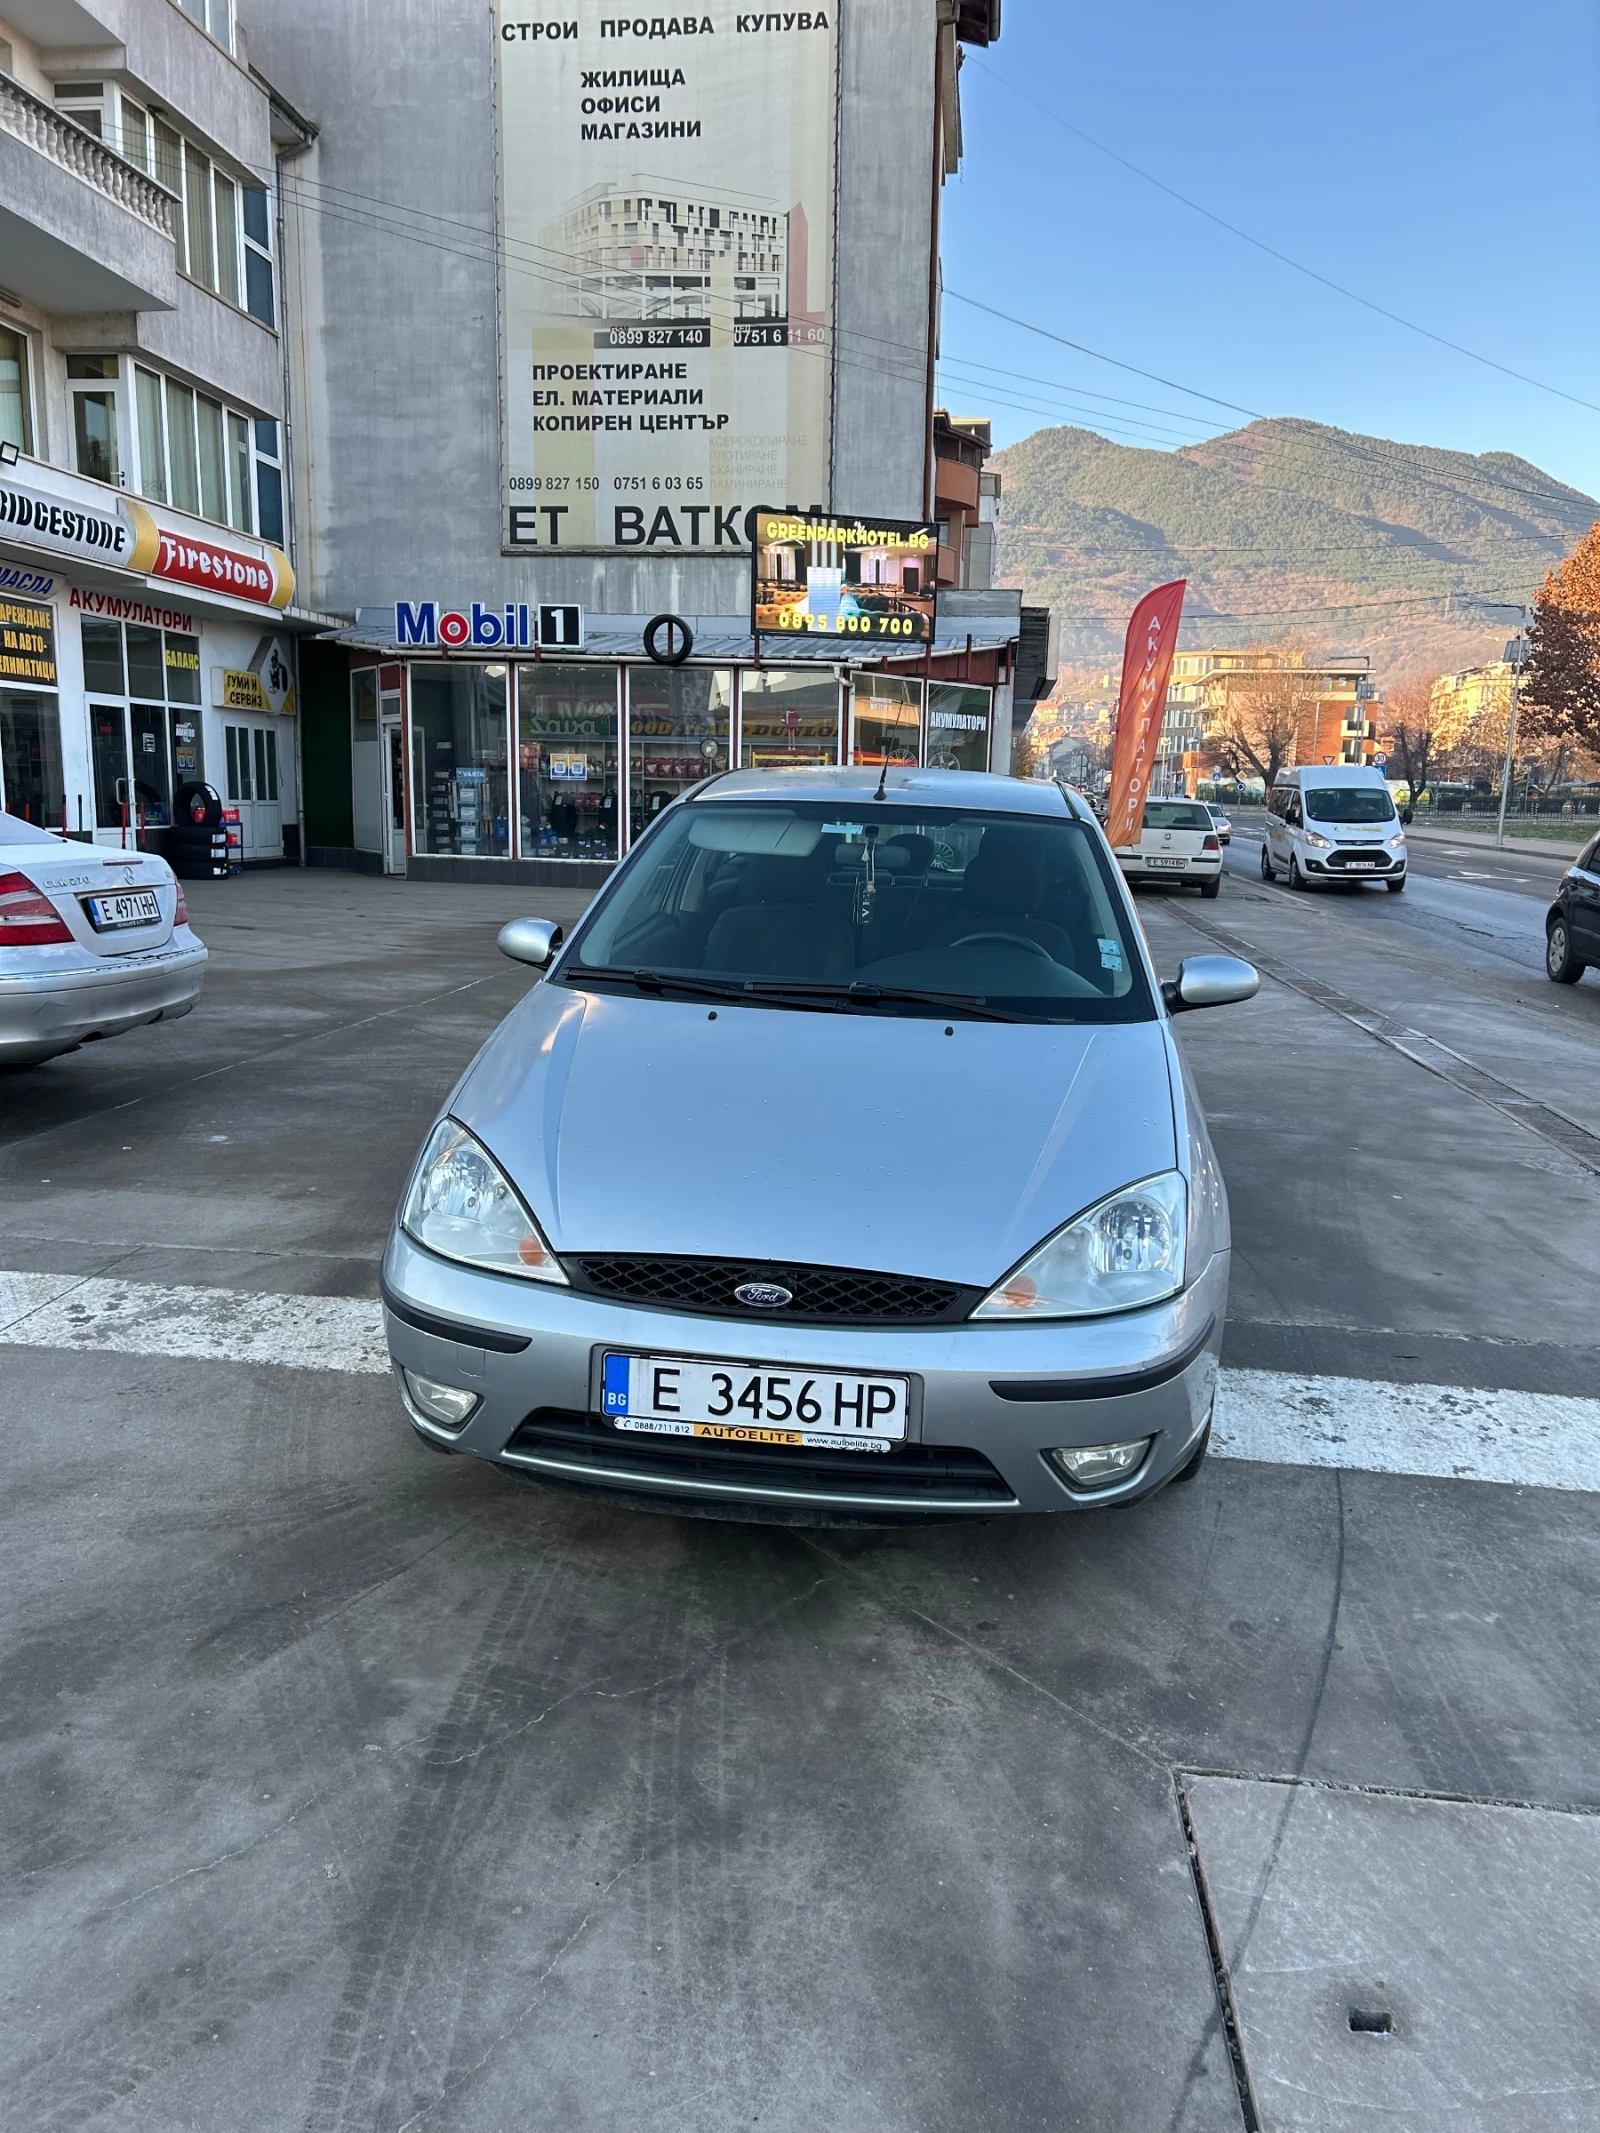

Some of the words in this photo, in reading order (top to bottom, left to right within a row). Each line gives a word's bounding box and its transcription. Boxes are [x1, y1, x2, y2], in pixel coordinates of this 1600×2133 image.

[501, 21, 579, 41] СТРОИ
[600, 16, 715, 39] ПРОДАВА
[736, 11, 830, 33] КУПУВА
[581, 68, 686, 89] ЖИЛИЩА
[581, 96, 660, 115] ОФИСИ
[581, 120, 702, 140] МАГАЗИНИ
[609, 329, 644, 345] 0899
[647, 330, 673, 345] 827
[678, 329, 703, 344] 140
[734, 328, 768, 344] 0751
[772, 328, 783, 343] 6
[787, 330, 802, 342] 11
[807, 328, 825, 342] 60
[533, 363, 687, 381] ПРОЕКТИРАНЕ
[533, 389, 566, 406] ЕЛ.
[572, 388, 703, 406] МАТЕРИАЛИ
[533, 414, 633, 431] КОПИРЕН
[639, 414, 729, 433] ЦЕНТЪР
[709, 435, 808, 447] КСЕРОКОПИРАНЕ
[709, 450, 777, 460] ПЛОТИРАНЕ
[709, 464, 777, 475] СКАНИРАНЕ
[509, 478, 542, 490] 0899
[546, 478, 570, 490] 827
[576, 477, 600, 490] 150
[613, 477, 648, 490] 0751
[652, 477, 661, 490] 6
[666, 477, 684, 490] 03
[688, 477, 703, 490] 65
[709, 479, 788, 489] ЛАМИНИРАНЕ
[509, 505, 568, 545] ЕТ
[614, 504, 823, 546] ВАТК
[766, 521, 929, 549] GREENPARKHOTEL.BG
[160, 536, 268, 589] Firestone
[69, 588, 192, 632] АКУМУЛАТОРИ
[395, 602, 530, 646] Mobil
[550, 609, 565, 642] 1
[779, 612, 828, 628] 0895
[835, 615, 871, 632] 800
[879, 618, 913, 635] 700
[3, 629, 18, 647] НА
[19, 632, 48, 653] АВТО-
[165, 649, 199, 671] БАЛАНС
[227, 674, 249, 688] ГУМИ
[251, 678, 258, 690] И
[230, 692, 262, 707] СЕРВИЗ
[630, 717, 730, 737] OODYEAR
[930, 712, 987, 731] АКУМУЛАТОРИ
[1124, 616, 1161, 832] АКУМУЛАТОРИ
[1375, 754, 1385, 763] 30
[463, 770, 485, 780] VARTA
[43, 877, 67, 889] CLK
[69, 876, 91, 886] 270
[101, 900, 112, 921] E
[115, 896, 142, 919] 4971
[747, 1287, 778, 1302] Ford
[607, 1392, 627, 1407] BG
[653, 1368, 681, 1412] E
[707, 1373, 822, 1424] 3456
[833, 1382, 896, 1429] HP
[634, 1422, 672, 1432] 0888/711
[701, 1427, 796, 1443] AUTOELITE
[806, 1436, 882, 1450] www.autoelite.bg
